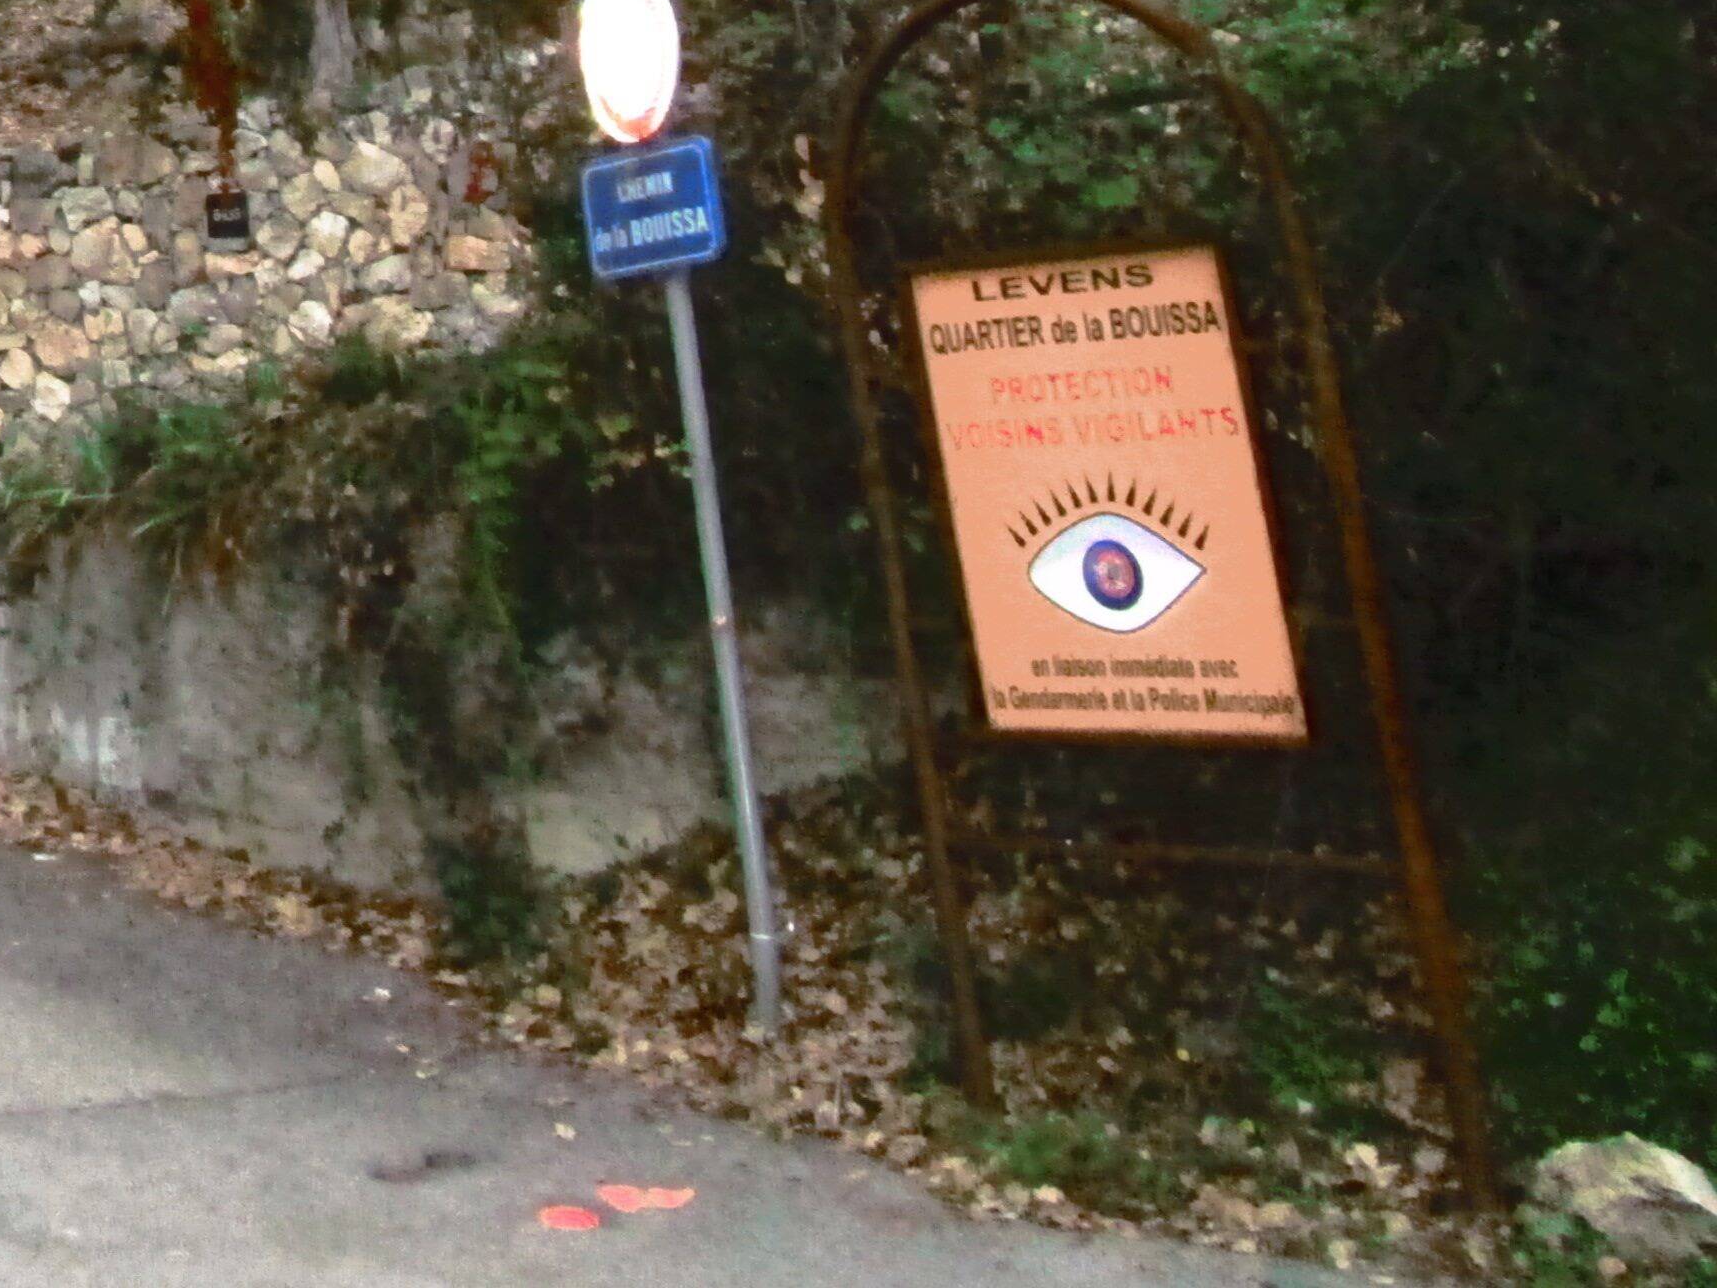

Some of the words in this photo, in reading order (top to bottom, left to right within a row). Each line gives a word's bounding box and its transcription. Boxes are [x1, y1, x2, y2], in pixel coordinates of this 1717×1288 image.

[616, 171, 674, 202] CHEMIN
[630, 205, 709, 247] BOUISSA
[971, 264, 1154, 302] LEVENS
[929, 315, 1045, 355] QUARTIER
[1051, 313, 1078, 345] de
[1082, 311, 1106, 342] la
[1108, 300, 1222, 340] BOUISSA
[989, 366, 1174, 404] PROTECTION
[946, 417, 1064, 451] VOISINS
[1074, 406, 1240, 443] VIGILANTS
[1031, 658, 1049, 677] en
[1051, 654, 1107, 677] liaison
[1199, 657, 1239, 679] avec
[1008, 685, 1109, 710] Gendarmerie
[1148, 686, 1201, 712] Police
[1201, 687, 1295, 718] Municipale
